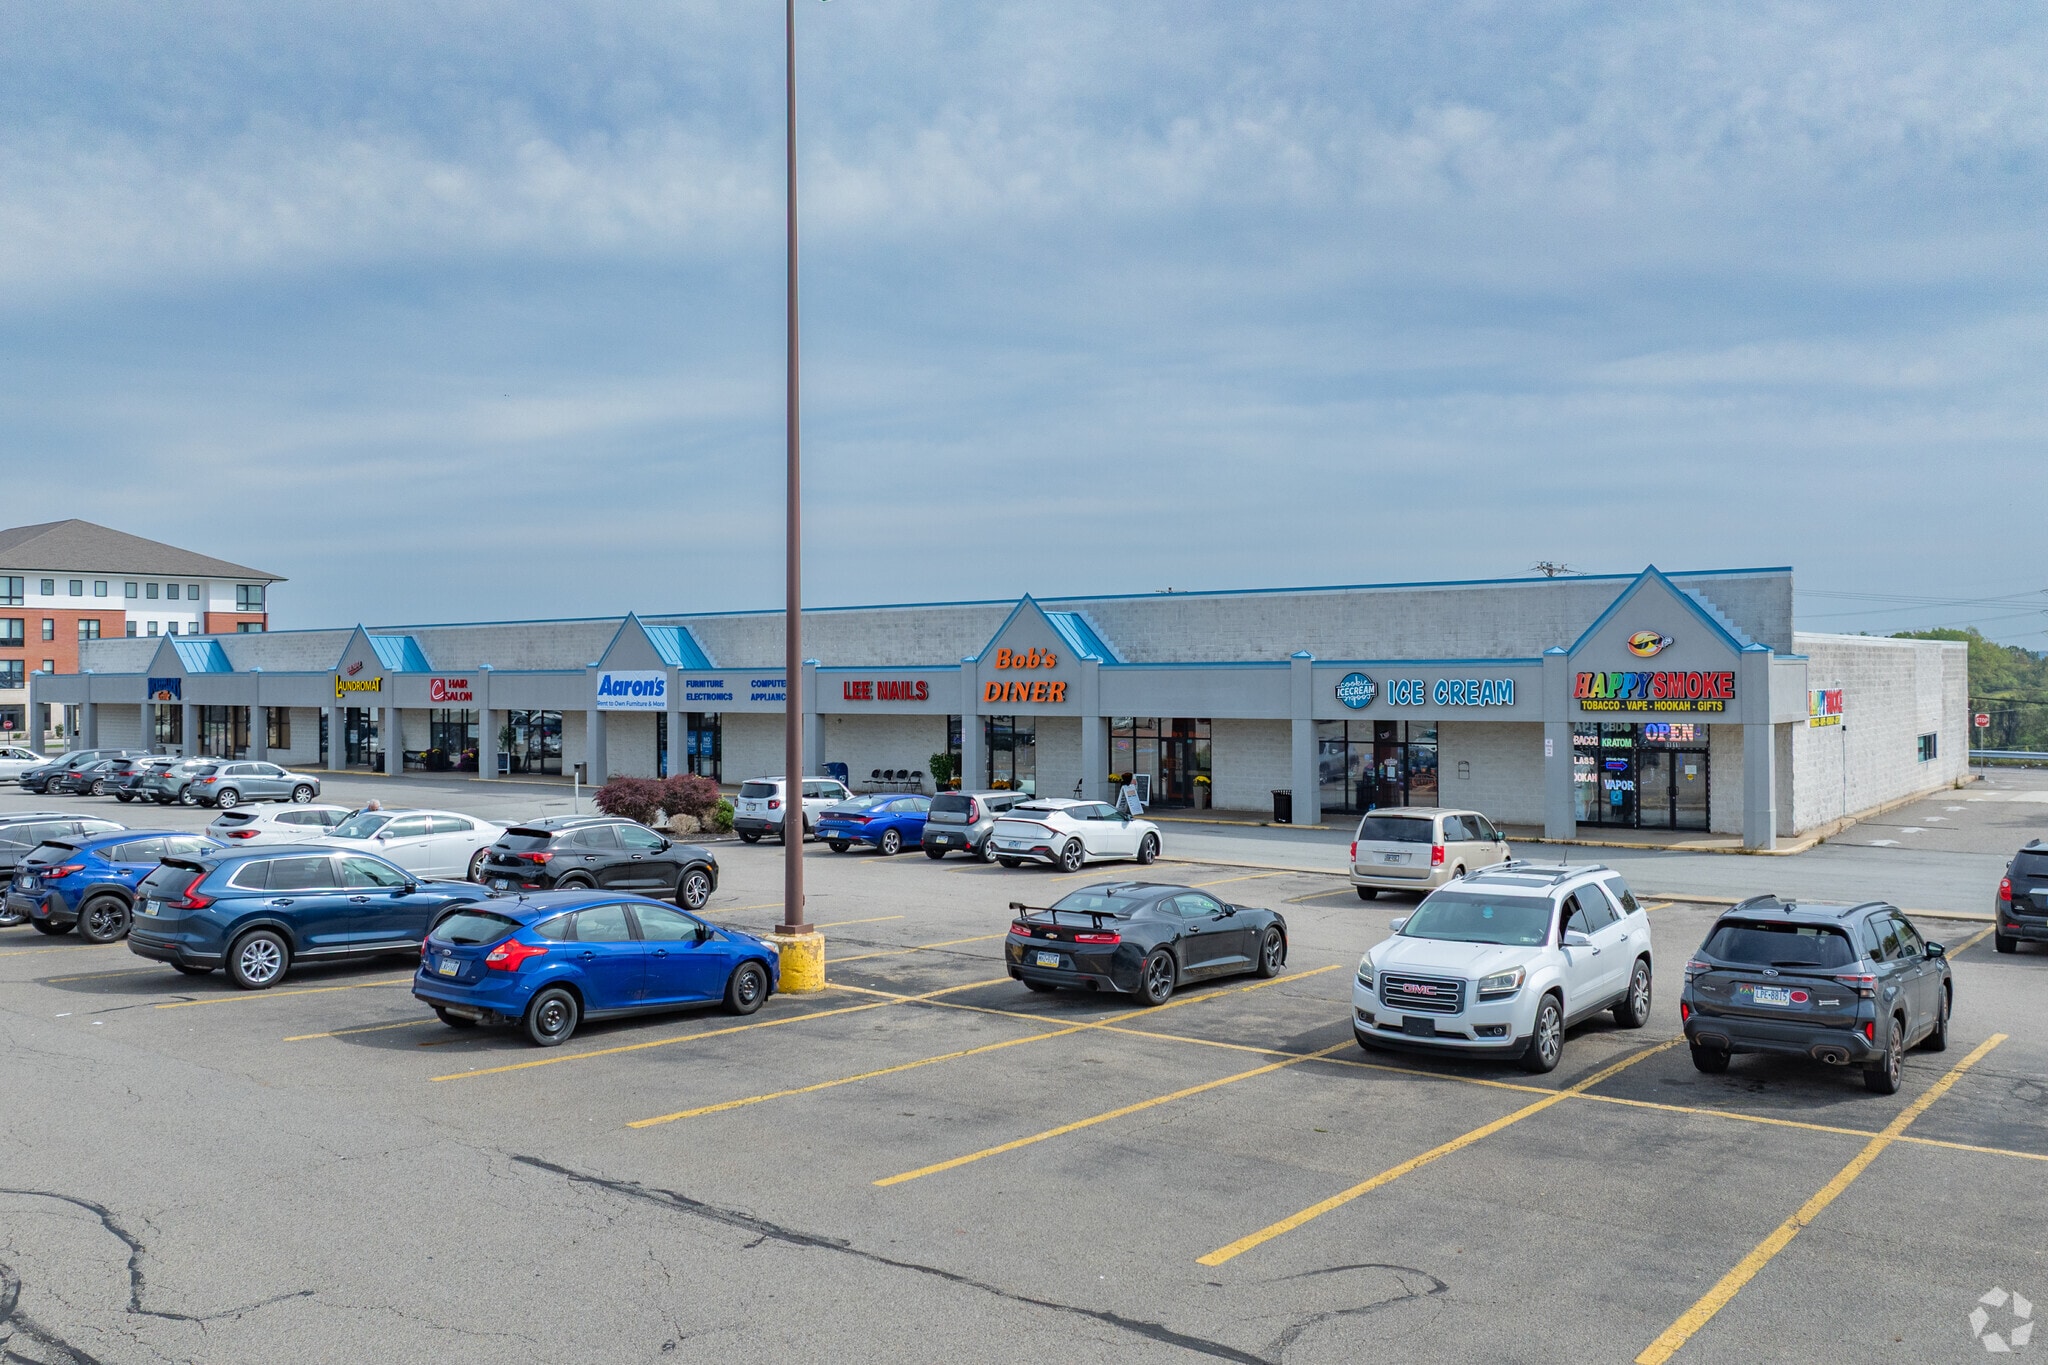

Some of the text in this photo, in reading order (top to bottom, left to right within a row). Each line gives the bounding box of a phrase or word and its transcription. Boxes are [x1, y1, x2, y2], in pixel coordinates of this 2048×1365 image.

[994, 647, 1058, 669] Bob's
[335, 675, 383, 698] LAUNDROMAT
[448, 679, 468, 689] HAIR
[598, 674, 665, 696] Aaron's
[686, 680, 724, 688] FURNITURE
[750, 680, 786, 688] COMPUTE
[1573, 671, 1735, 699] HAPPY SMOKE
[445, 691, 473, 701] SALON
[843, 680, 930, 701] LEE NAILS
[983, 681, 1067, 702] DINER
[1387, 679, 1516, 707] ICE CREAM
[686, 692, 733, 701] ELECTRONICS
[750, 692, 786, 701] APPLIANC
[1582, 701, 1620, 711] TOBACCO
[1626, 701, 1648, 711] VAPE
[1654, 702, 1691, 711] HOOKAH
[1697, 702, 1723, 711] GIFTS
[1574, 722, 1597, 732] APE
[1645, 723, 1694, 742] OPEN
[1573, 735, 1599, 746] BACCO
[1601, 738, 1632, 747] KRATOM
[1573, 756, 1595, 765] LASS
[1604, 779, 1634, 791] VAPOR
[1403, 983, 1437, 996] GMC
